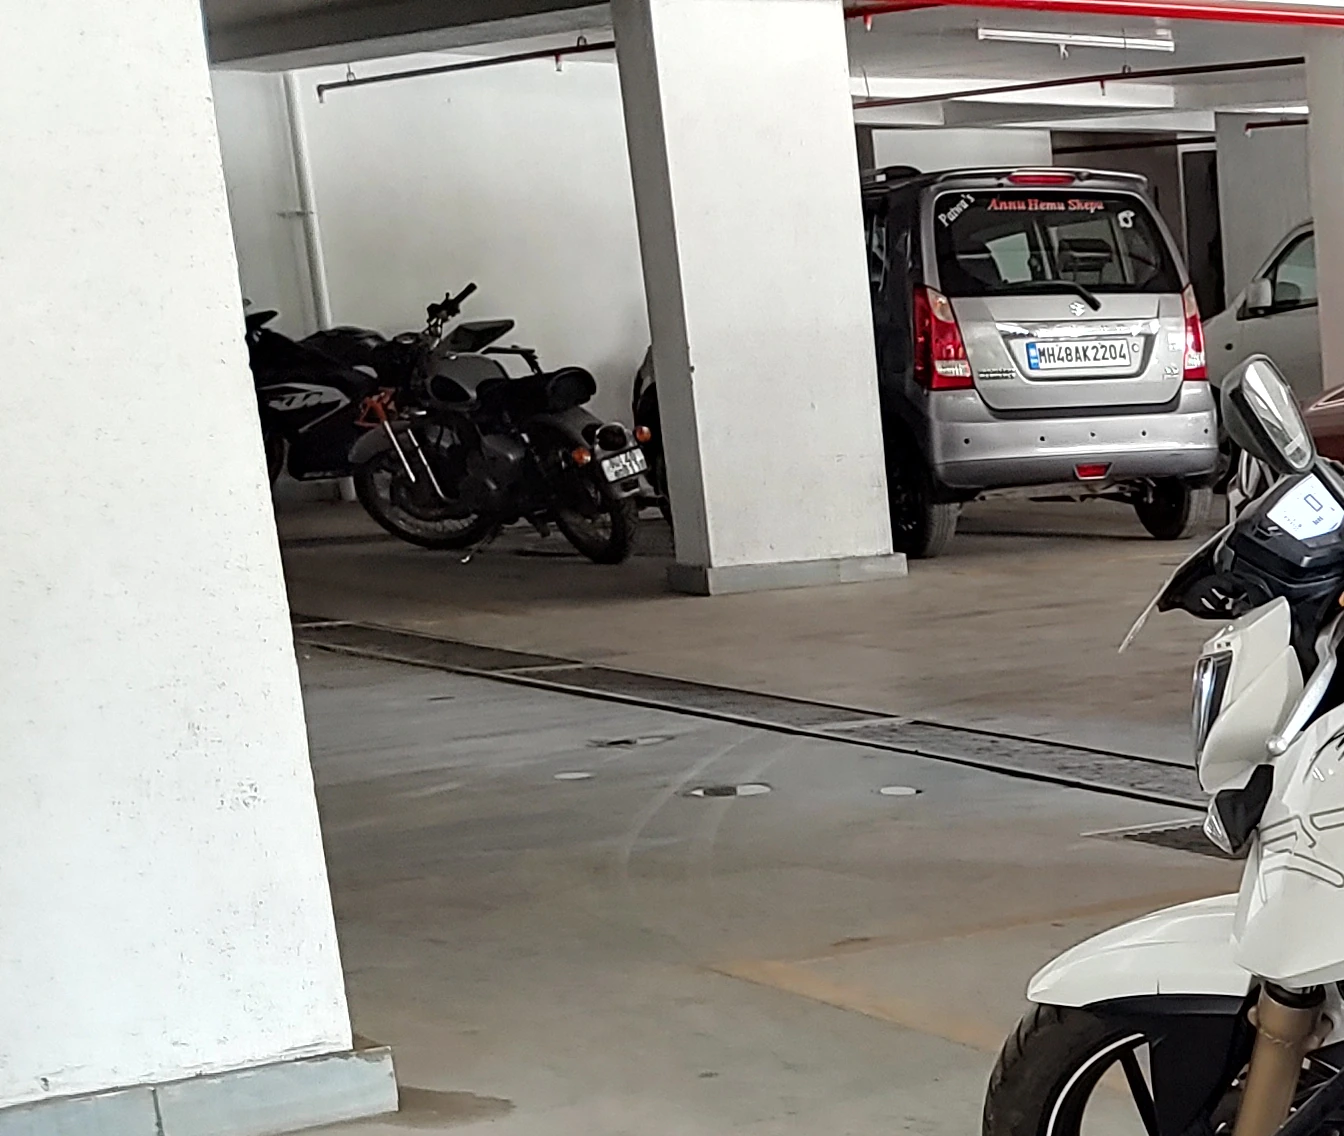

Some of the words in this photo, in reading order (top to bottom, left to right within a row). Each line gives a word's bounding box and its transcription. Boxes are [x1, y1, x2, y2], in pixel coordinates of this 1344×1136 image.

[987, 199, 1026, 211] Annu
[1028, 199, 1065, 211] Hemu
[1038, 344, 1126, 363] MH48AK2204
